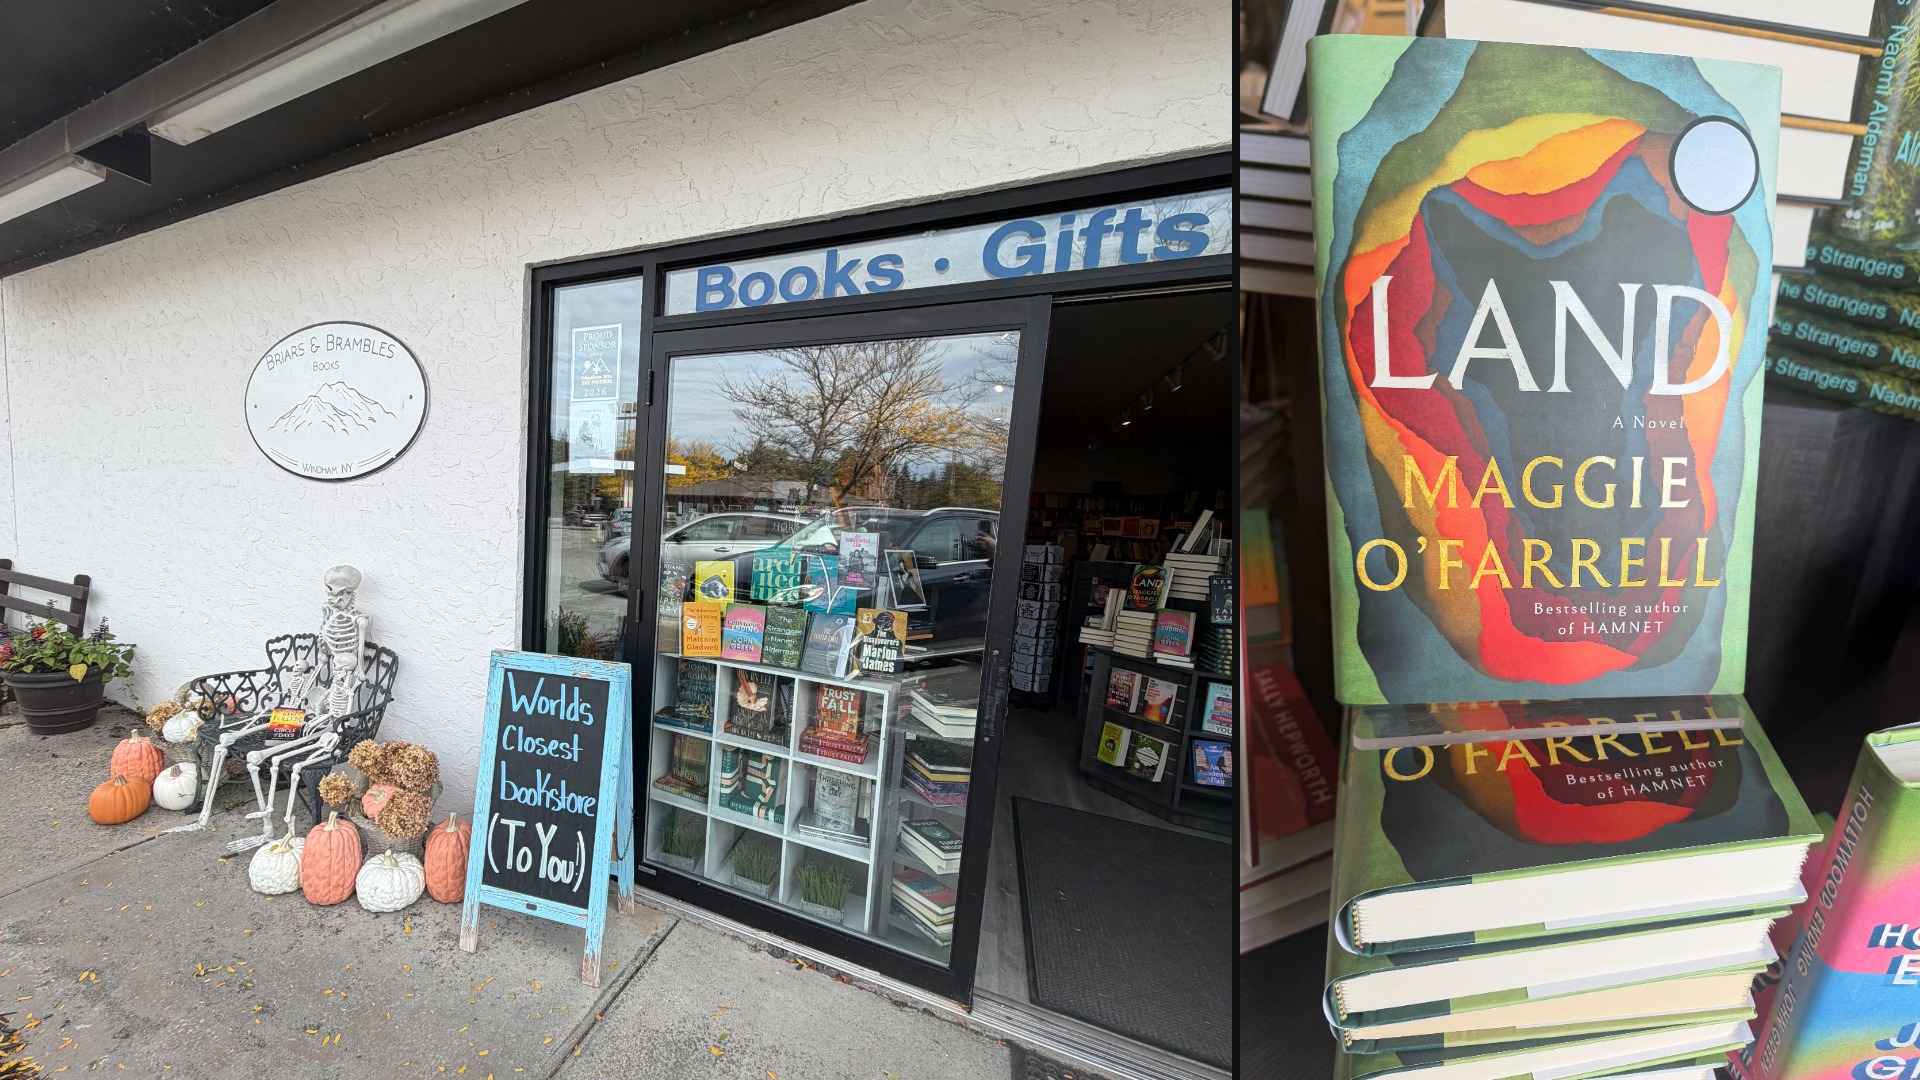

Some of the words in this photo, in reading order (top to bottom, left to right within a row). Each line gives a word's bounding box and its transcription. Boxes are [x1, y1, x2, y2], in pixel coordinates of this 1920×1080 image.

[1876, 25, 1910, 97] Naomi
[1850, 100, 1889, 197] Alderman
[696, 248, 905, 312] Books
[982, 208, 1210, 280] Gifts
[1820, 245, 1905, 279] Strangers
[1803, 284, 1888, 320] Strangers
[265, 343, 305, 371] BRIARS
[310, 337, 320, 353] &
[326, 334, 396, 359] BRAMBLES
[1370, 275, 1734, 396] LAND
[1795, 321, 1879, 358] Strangers
[312, 361, 340, 372] BOOKS
[1775, 357, 1858, 393] Strangers
[1612, 415, 1625, 429] A
[1633, 415, 1687, 429] Novel
[303, 463, 338, 474] WINDHAM
[341, 463, 352, 473] NY
[1400, 455, 1692, 511] MAGGIE
[1355, 535, 1722, 592] O'FARRELL
[1534, 601, 1628, 616] Bestselling
[1634, 601, 1689, 615] author
[1558, 621, 1576, 636] of
[1583, 620, 1664, 634] HAMNET
[862, 645, 897, 661] Marlon
[862, 658, 895, 673] James
[822, 698, 857, 714] FALL
[823, 687, 856, 702] TRUST
[502, 724, 584, 763] Closest
[500, 760, 596, 817] bookstore
[1566, 763, 1664, 787] Bestselling
[1669, 757, 1725, 773] author
[1597, 787, 1614, 800] of
[1623, 775, 1708, 797] HAMNET
[1820, 785, 1875, 910] HOLLYWOOD
[1798, 909, 1828, 977] ENDING
